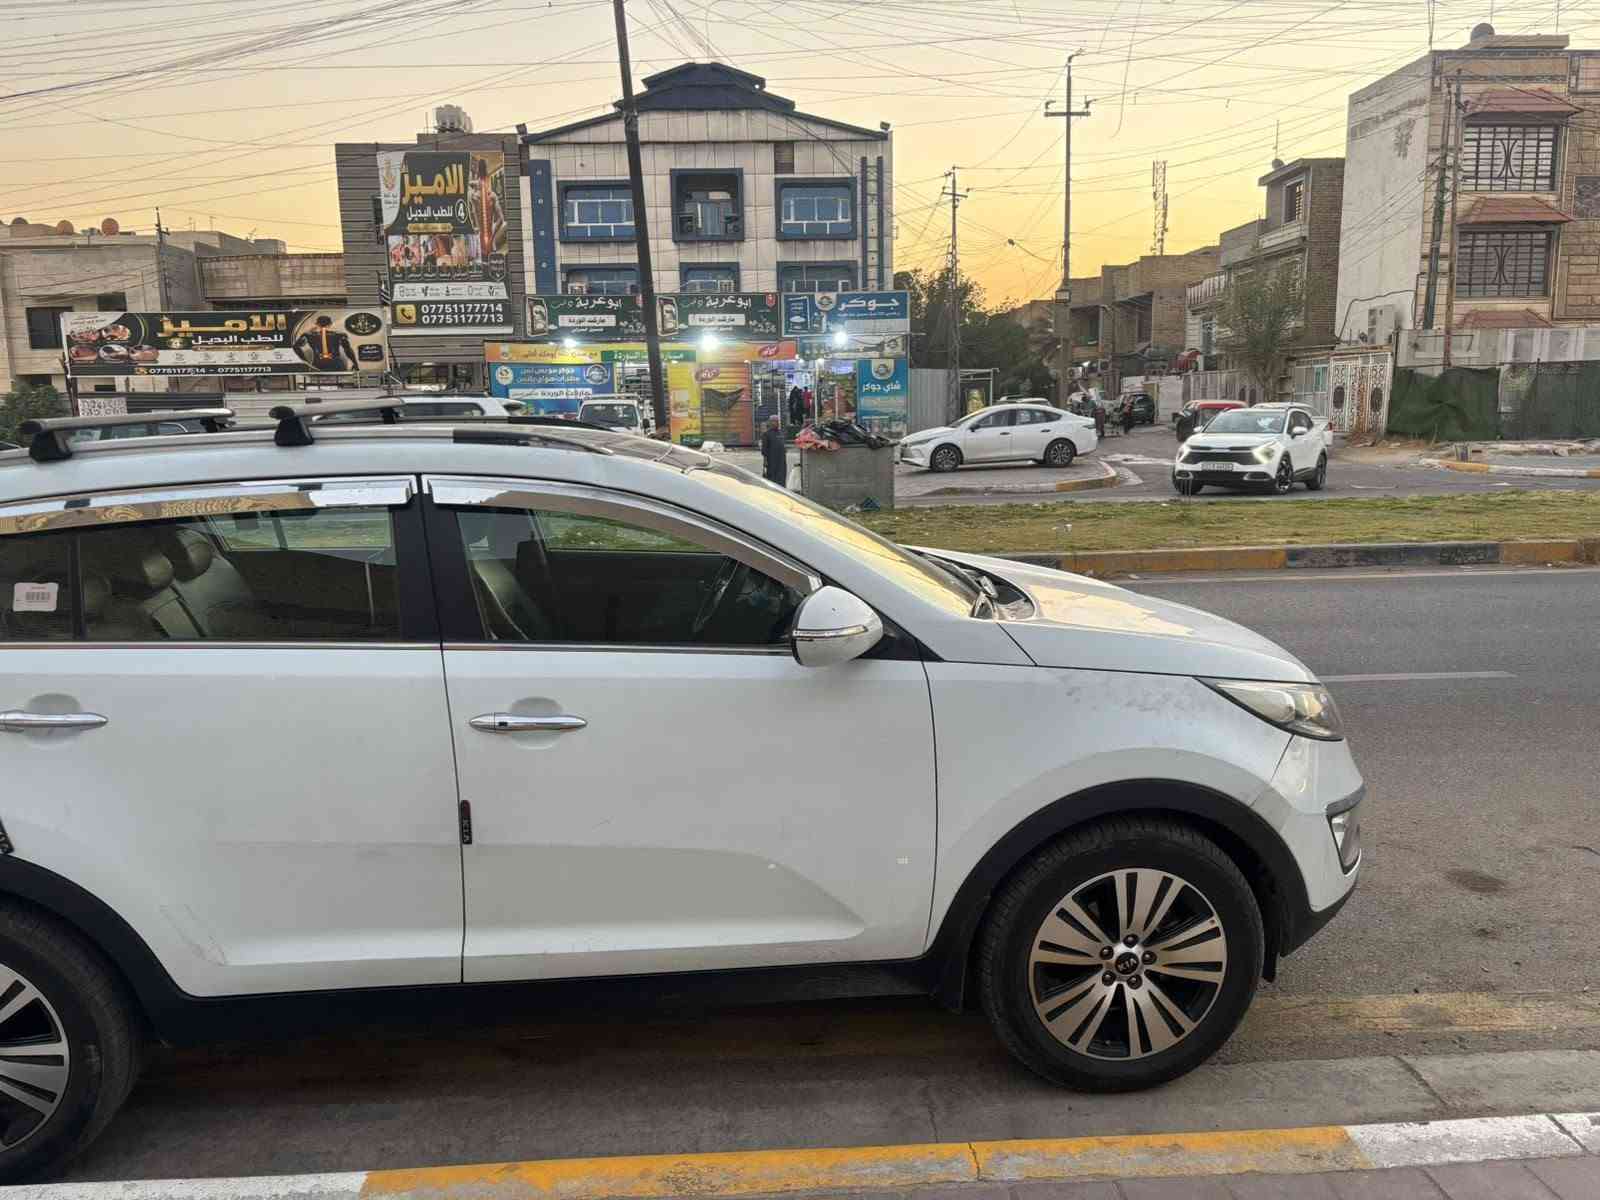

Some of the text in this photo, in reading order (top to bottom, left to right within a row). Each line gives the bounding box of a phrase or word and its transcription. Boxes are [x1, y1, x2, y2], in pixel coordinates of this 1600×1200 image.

[406, 206, 453, 221] للطب البديل
[421, 304, 502, 314] 07751177714
[838, 297, 900, 312] جوكر
[422, 315, 504, 325] 07751177713
[192, 334, 284, 345] للطب البديل
